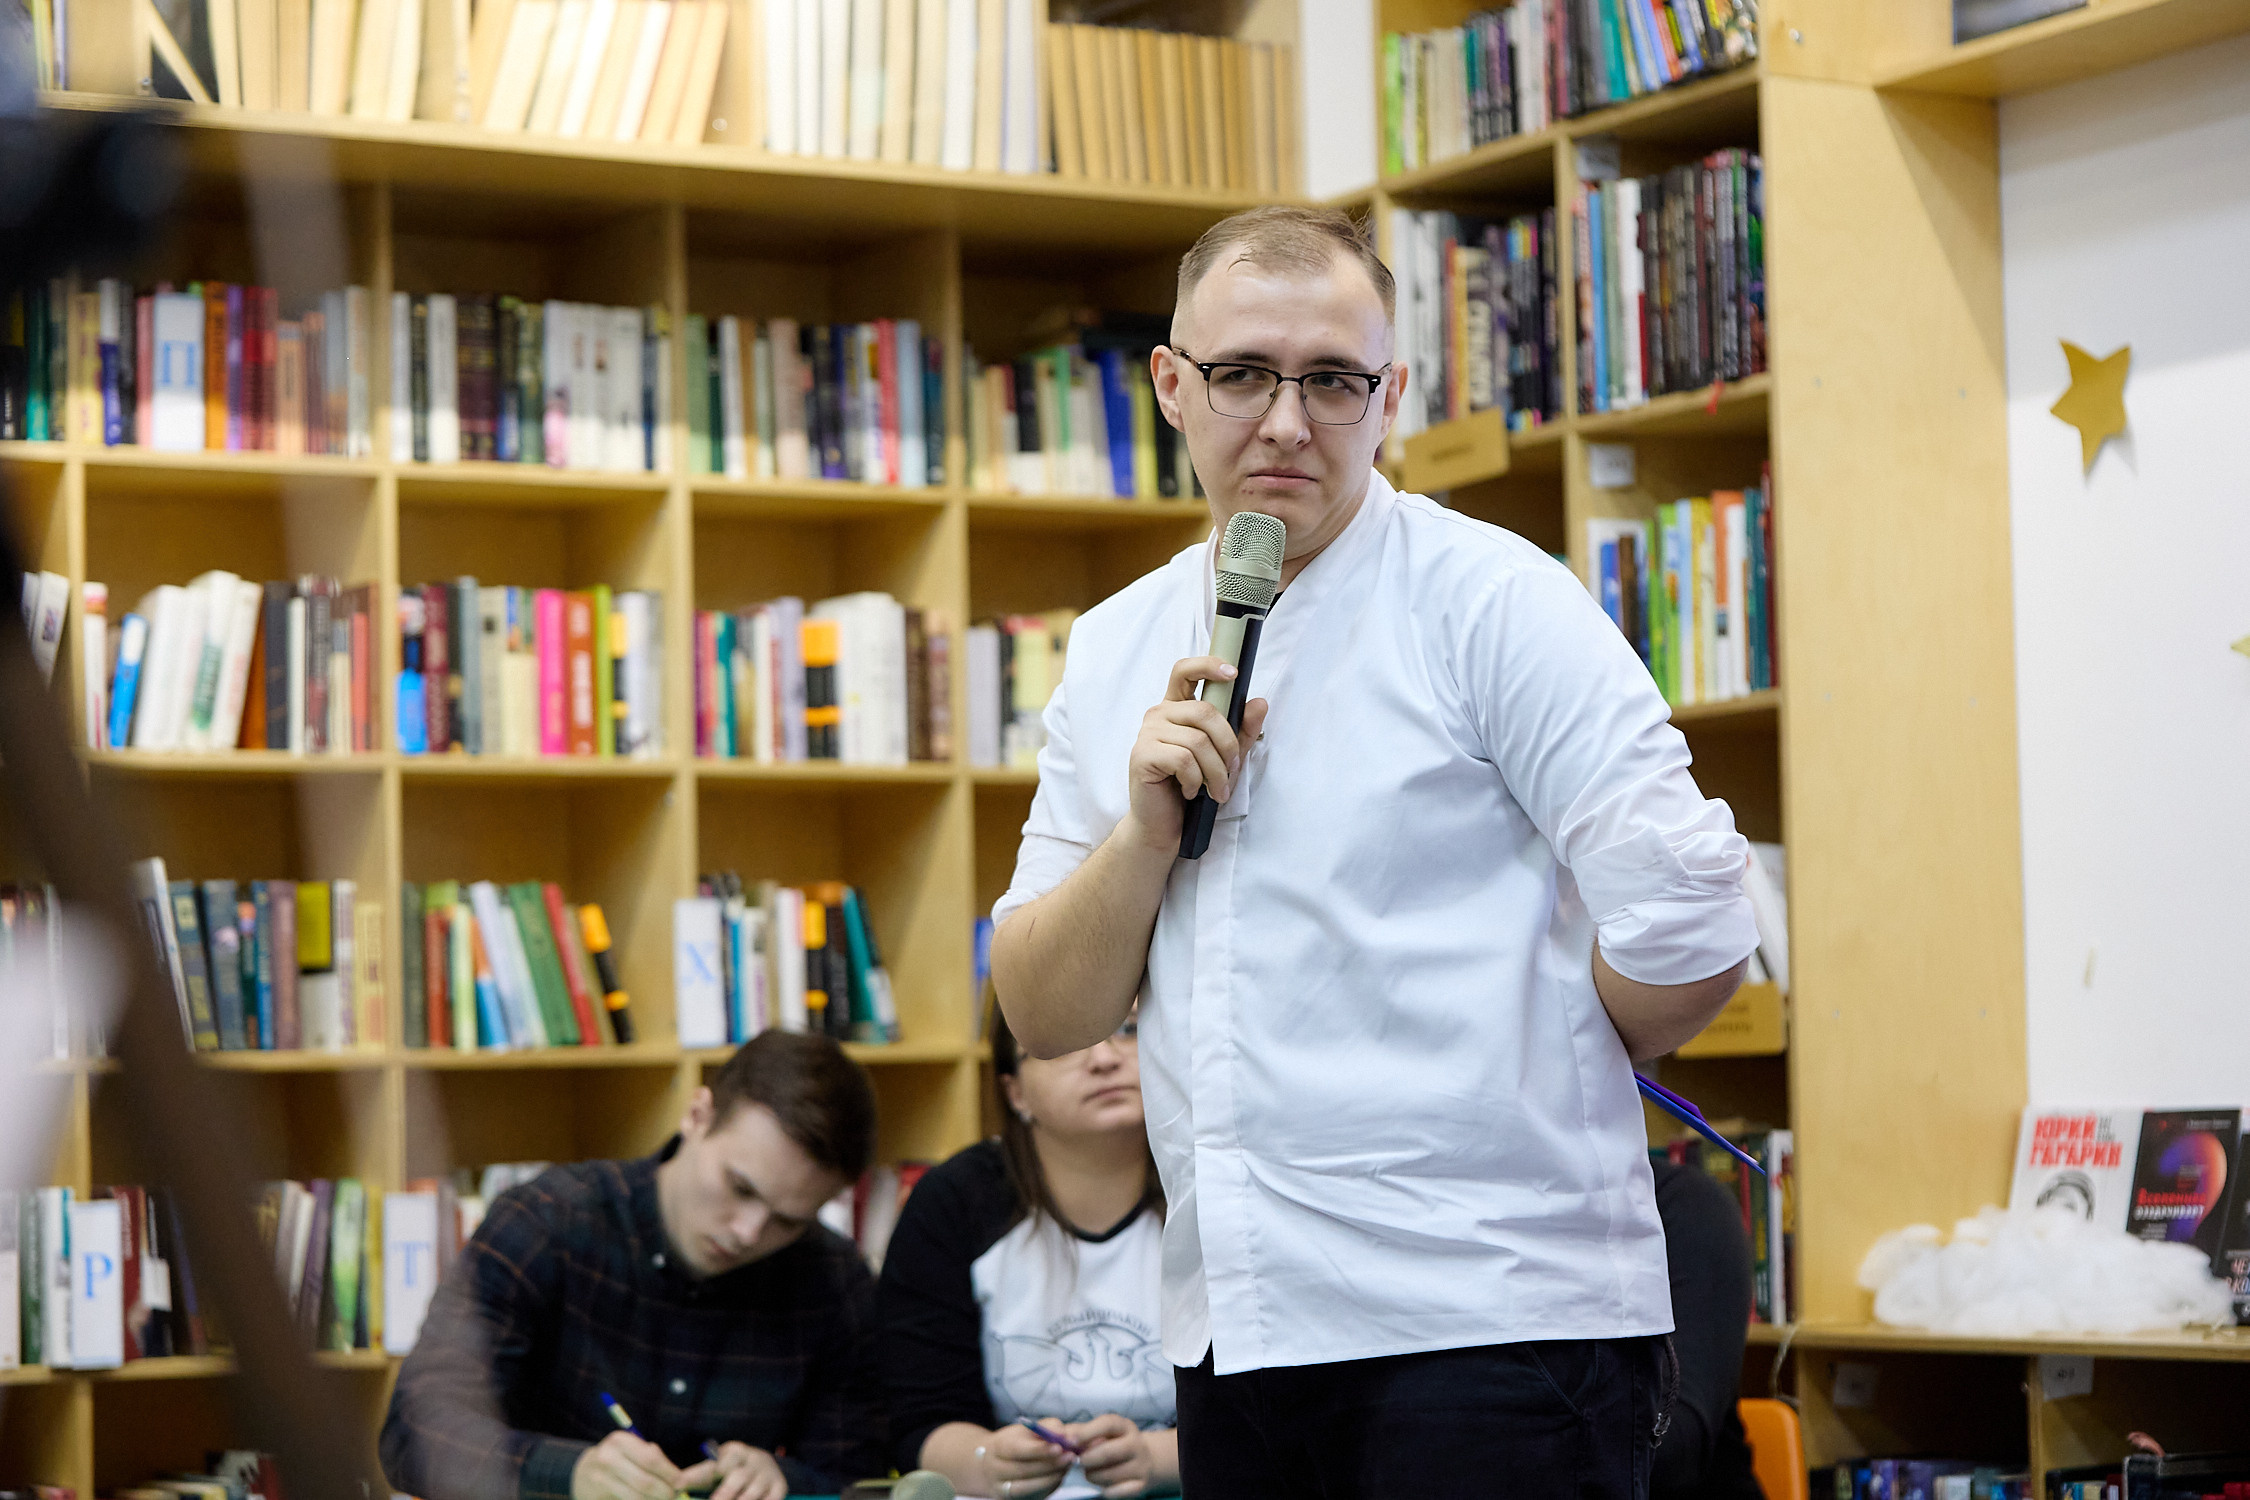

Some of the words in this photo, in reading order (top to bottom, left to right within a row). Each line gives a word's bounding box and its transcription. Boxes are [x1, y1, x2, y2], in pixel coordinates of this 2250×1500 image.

[162, 340, 197, 386] П
[2035, 1113, 2097, 1139] ЮРИЙ
[2029, 1142, 2122, 1167] ГАГАРИН
[389, 1240, 431, 1288] Т
